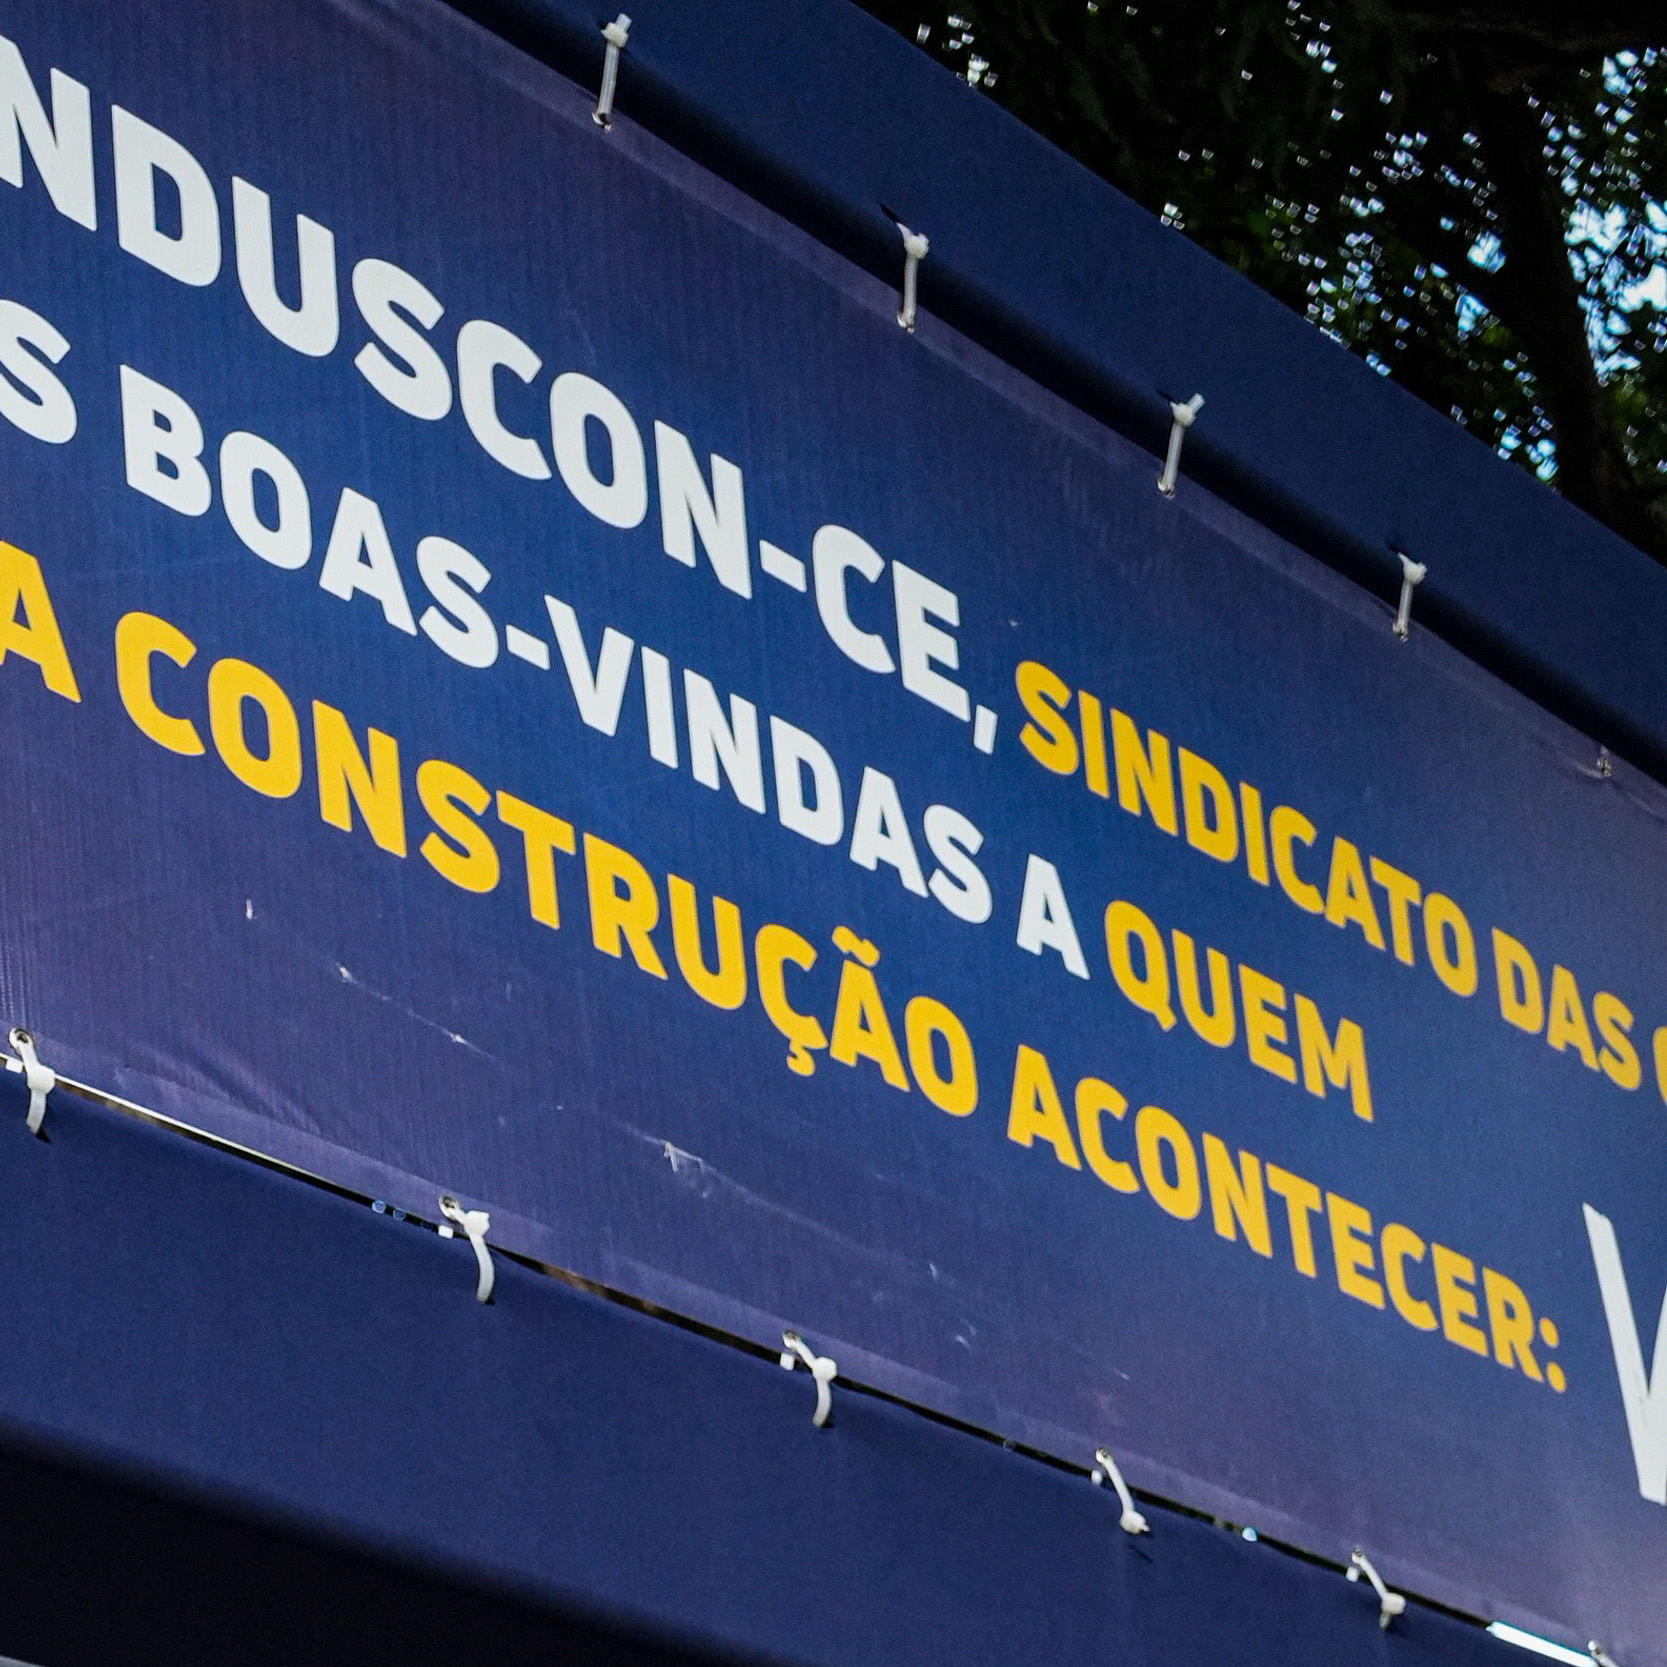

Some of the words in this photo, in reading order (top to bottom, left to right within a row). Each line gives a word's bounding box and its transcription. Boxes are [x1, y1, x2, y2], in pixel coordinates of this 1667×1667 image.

[115, 611, 978, 1117] CONSTRUÇÃO
[1007, 1045, 1565, 1391] ACONTECER:
[119, 364, 992, 923] BOAS-VINDAS
[1016, 854, 1089, 980] A
[1105, 900, 1373, 1121] QUEM
[1016, 660, 1478, 997] SINDICATO
[1492, 926, 1641, 1090] DAS
